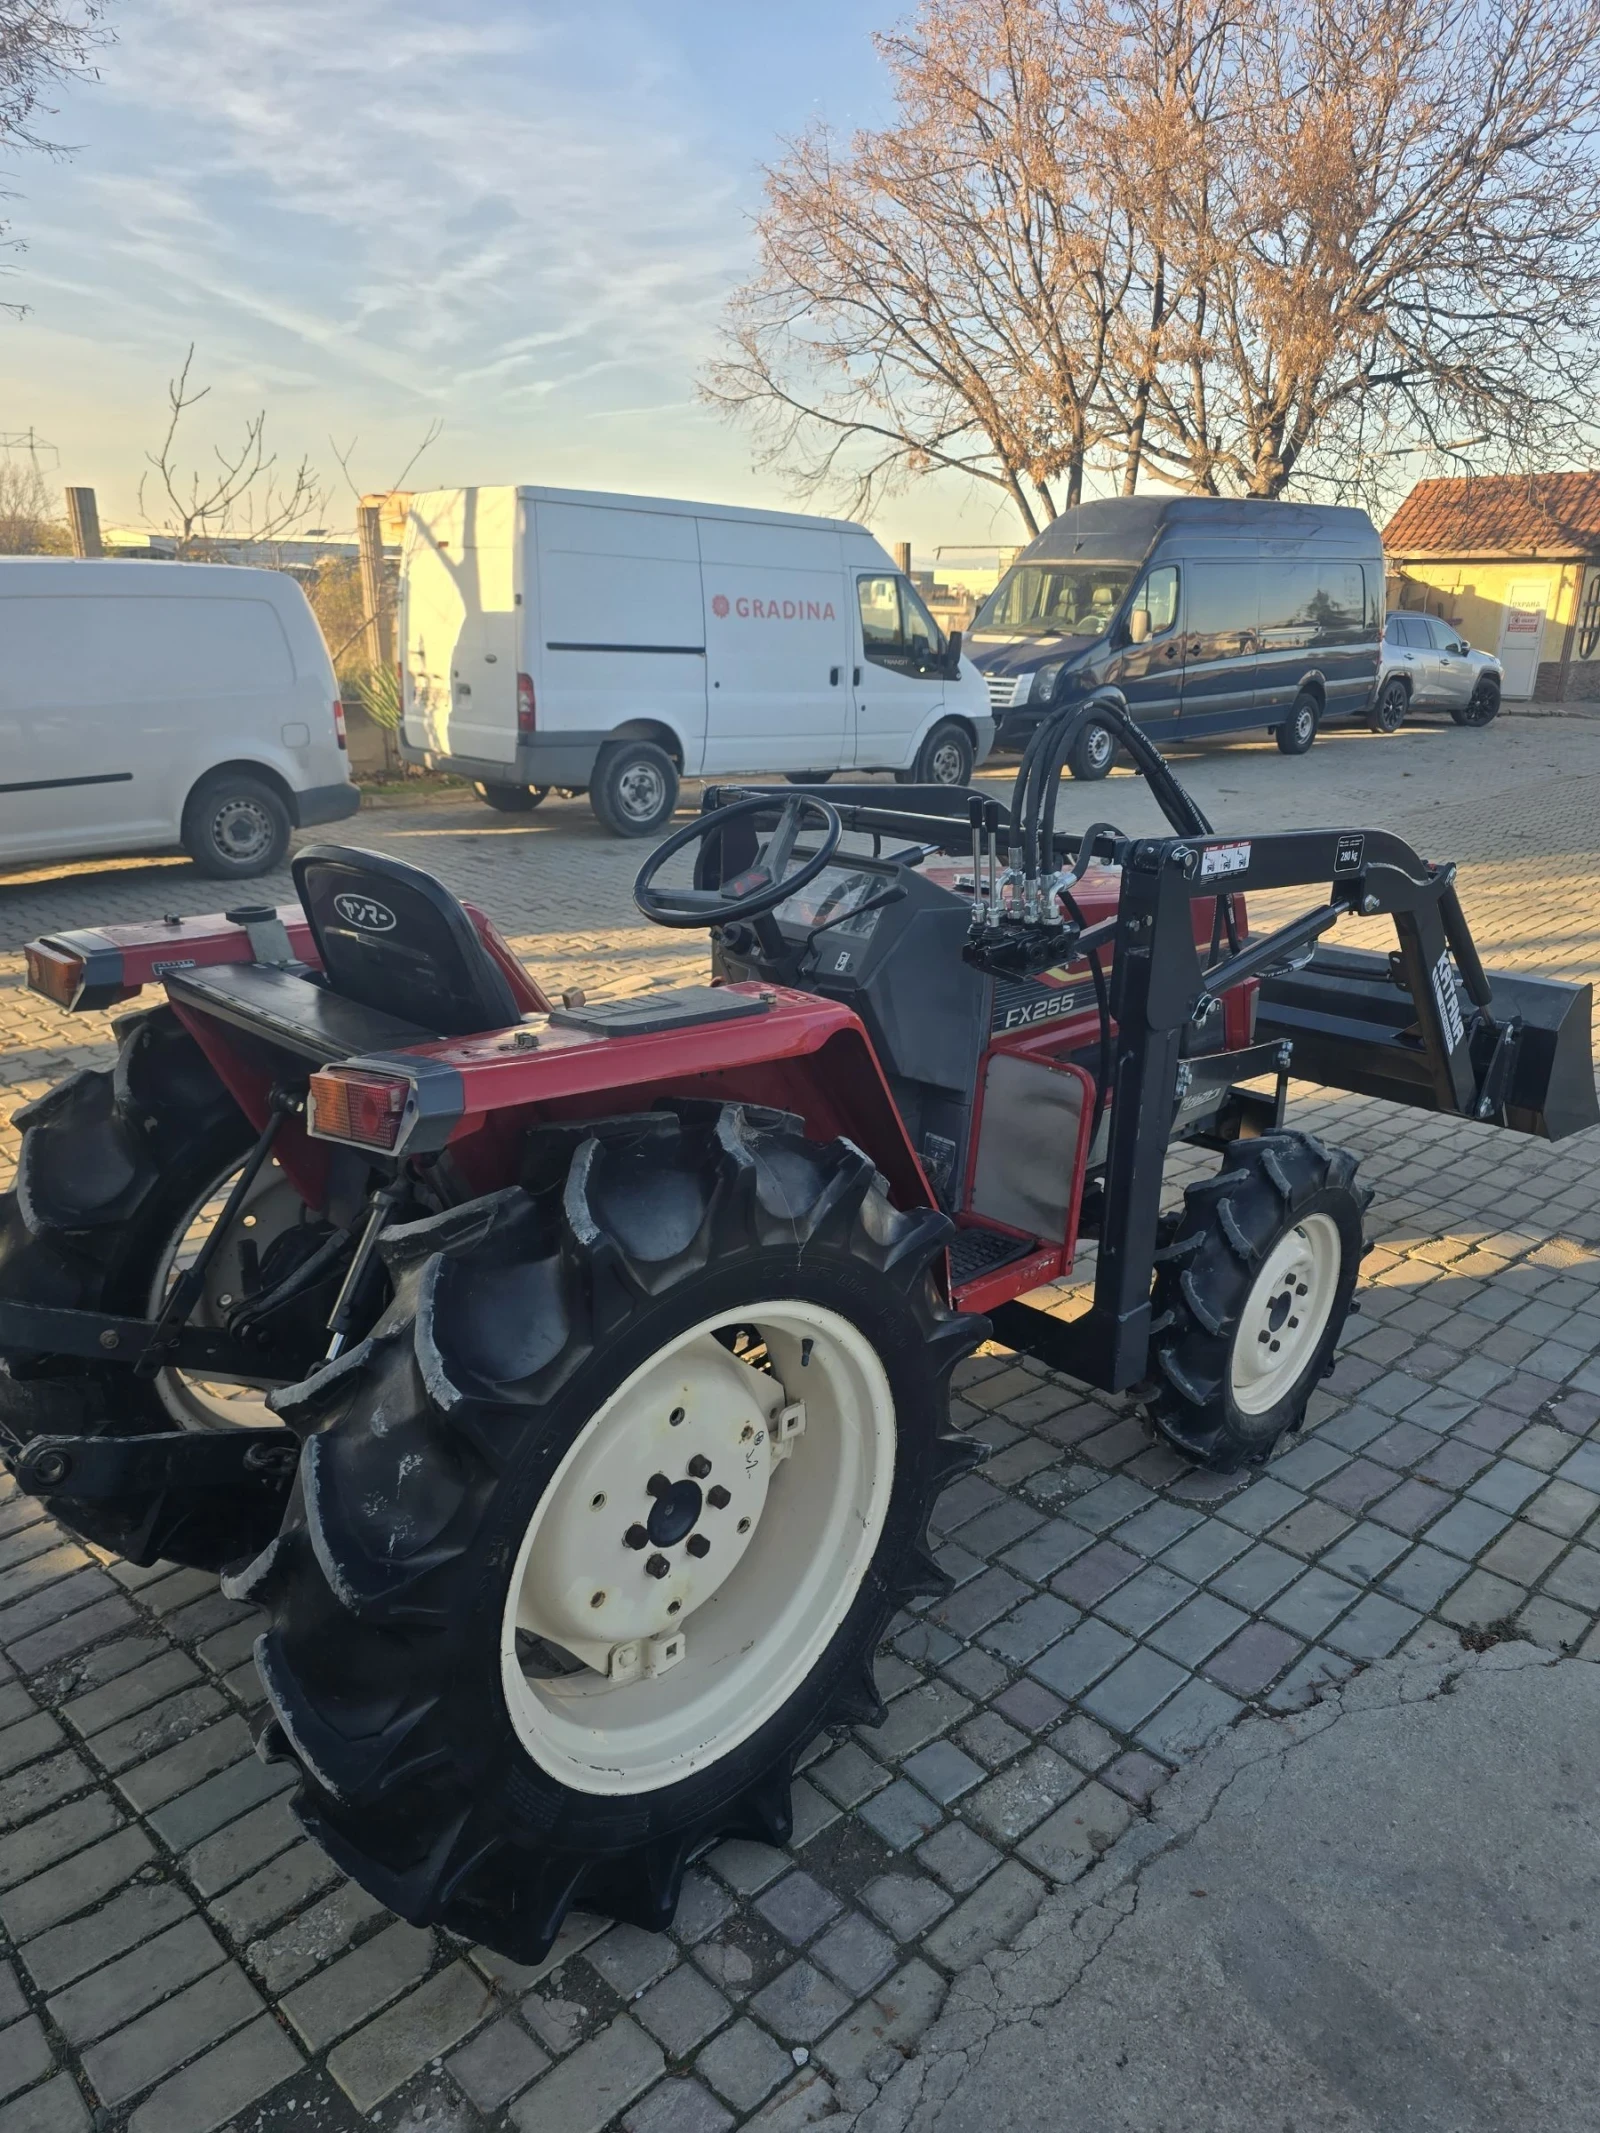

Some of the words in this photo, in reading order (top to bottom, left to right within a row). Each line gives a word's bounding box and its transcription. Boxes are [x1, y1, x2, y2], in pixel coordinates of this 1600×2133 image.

[736, 597, 836, 621] GRADINA
[1340, 850, 1351, 862] 280
[1351, 849, 1359, 862] kg
[342, 898, 388, 925] ヤンマー
[1005, 992, 1076, 1028] FX255
[1437, 948, 1465, 1046] KATANA
